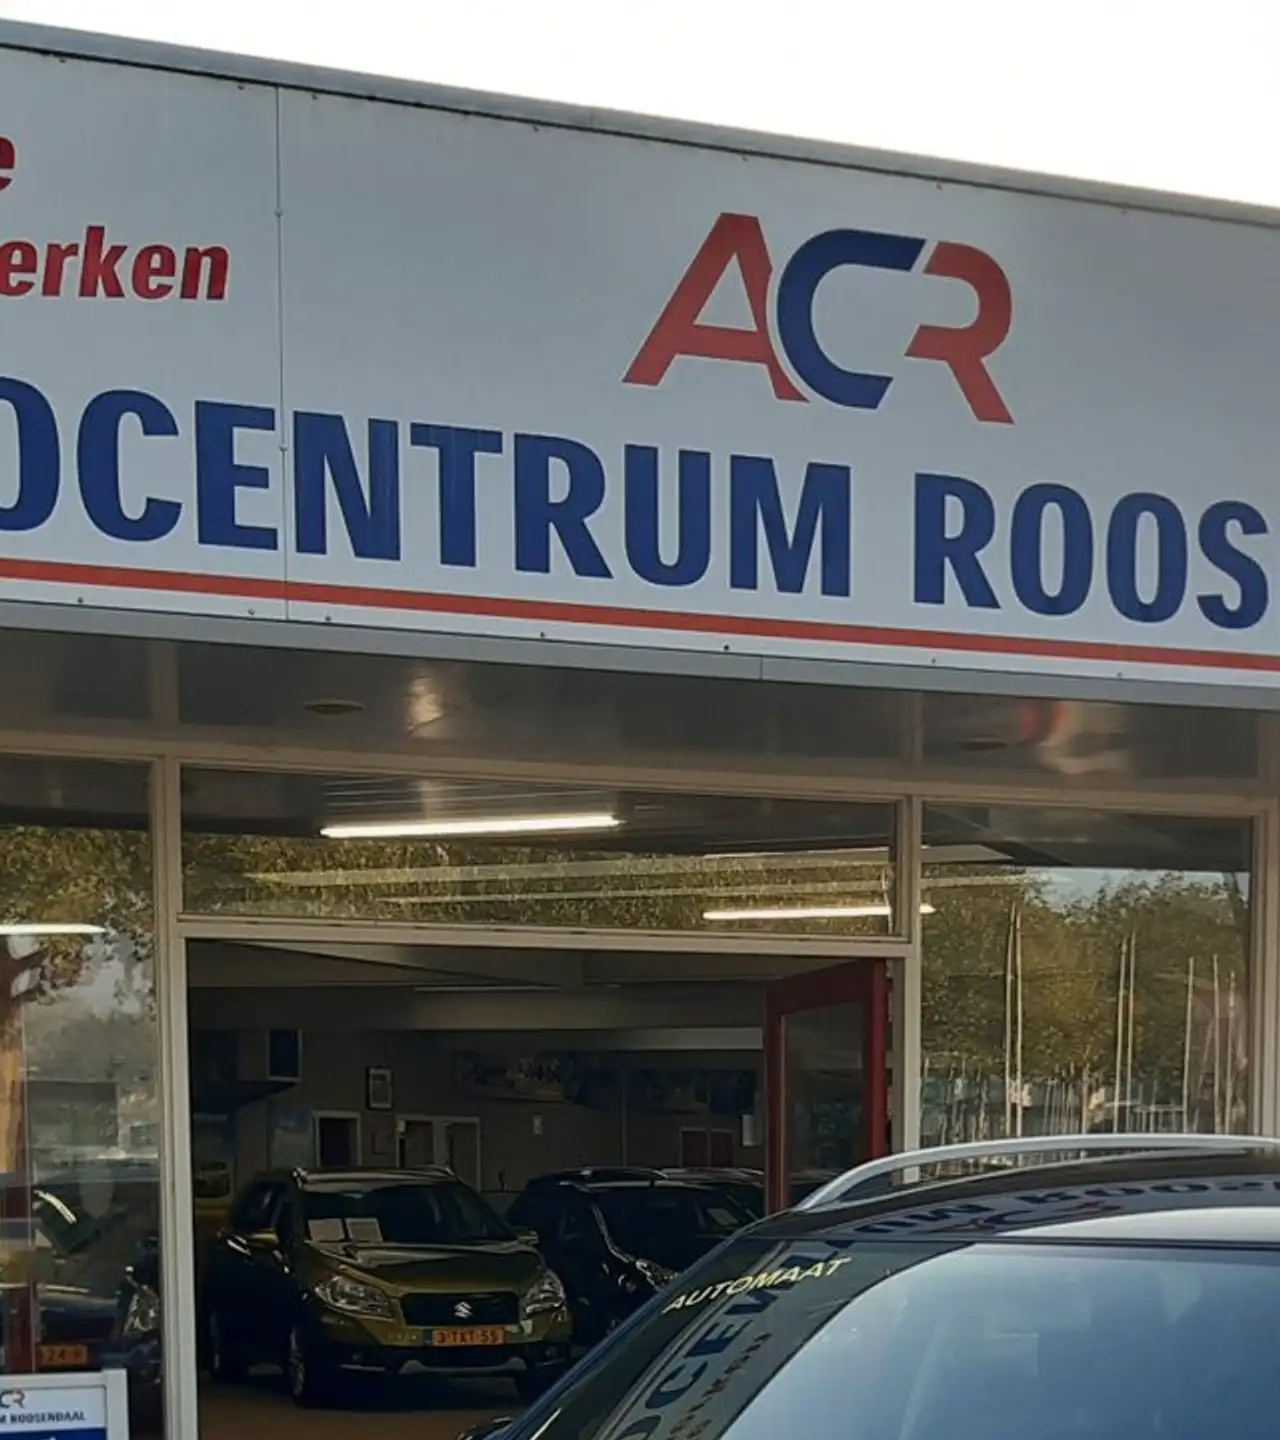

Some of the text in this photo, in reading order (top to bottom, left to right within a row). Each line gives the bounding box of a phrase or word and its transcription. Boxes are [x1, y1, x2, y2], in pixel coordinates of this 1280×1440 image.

[621, 212, 1015, 425] ACR
[661, 1256, 853, 1315] AUTOMAAT
[10, 1410, 87, 1424] ROOSENDAAL
